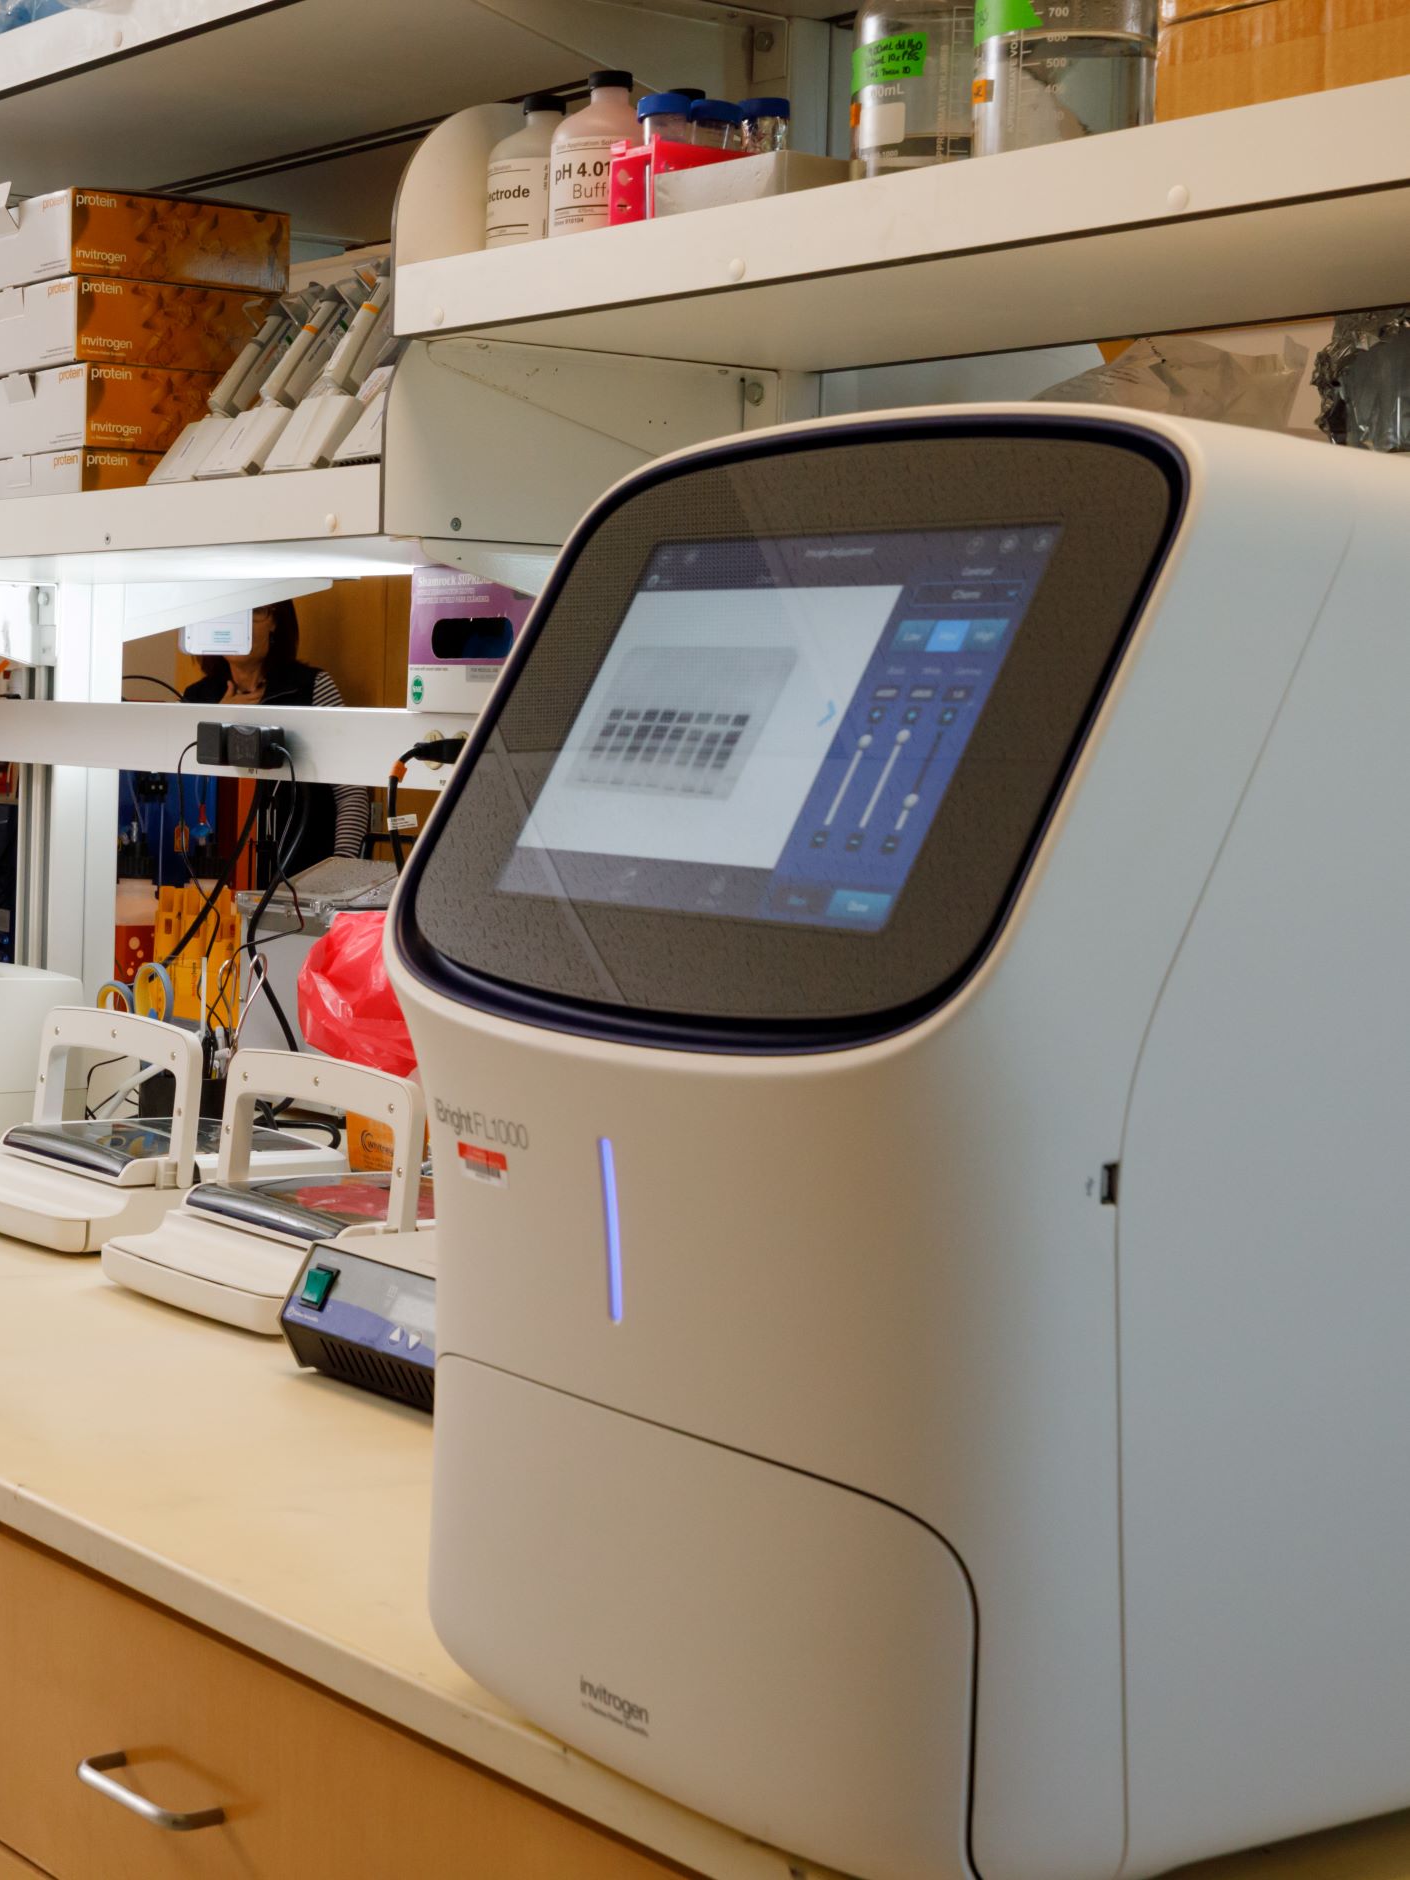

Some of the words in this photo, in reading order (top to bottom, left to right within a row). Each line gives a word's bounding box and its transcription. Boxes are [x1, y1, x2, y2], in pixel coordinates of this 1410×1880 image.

[1048, 7, 1070, 17] 700
[1046, 57, 1067, 68] 500
[555, 162, 572, 185] pH
[76, 194, 117, 209] protein
[76, 247, 127, 264] invitrogen
[81, 281, 124, 296] protein
[81, 334, 133, 351] invitrogen
[58, 366, 84, 384] protein
[91, 367, 133, 381] protein
[90, 420, 142, 437] invitrogen
[53, 453, 79, 470] protein
[86, 453, 129, 468] protein
[473, 1111, 530, 1151] FL1000
[579, 1673, 650, 1725] invitrogen
